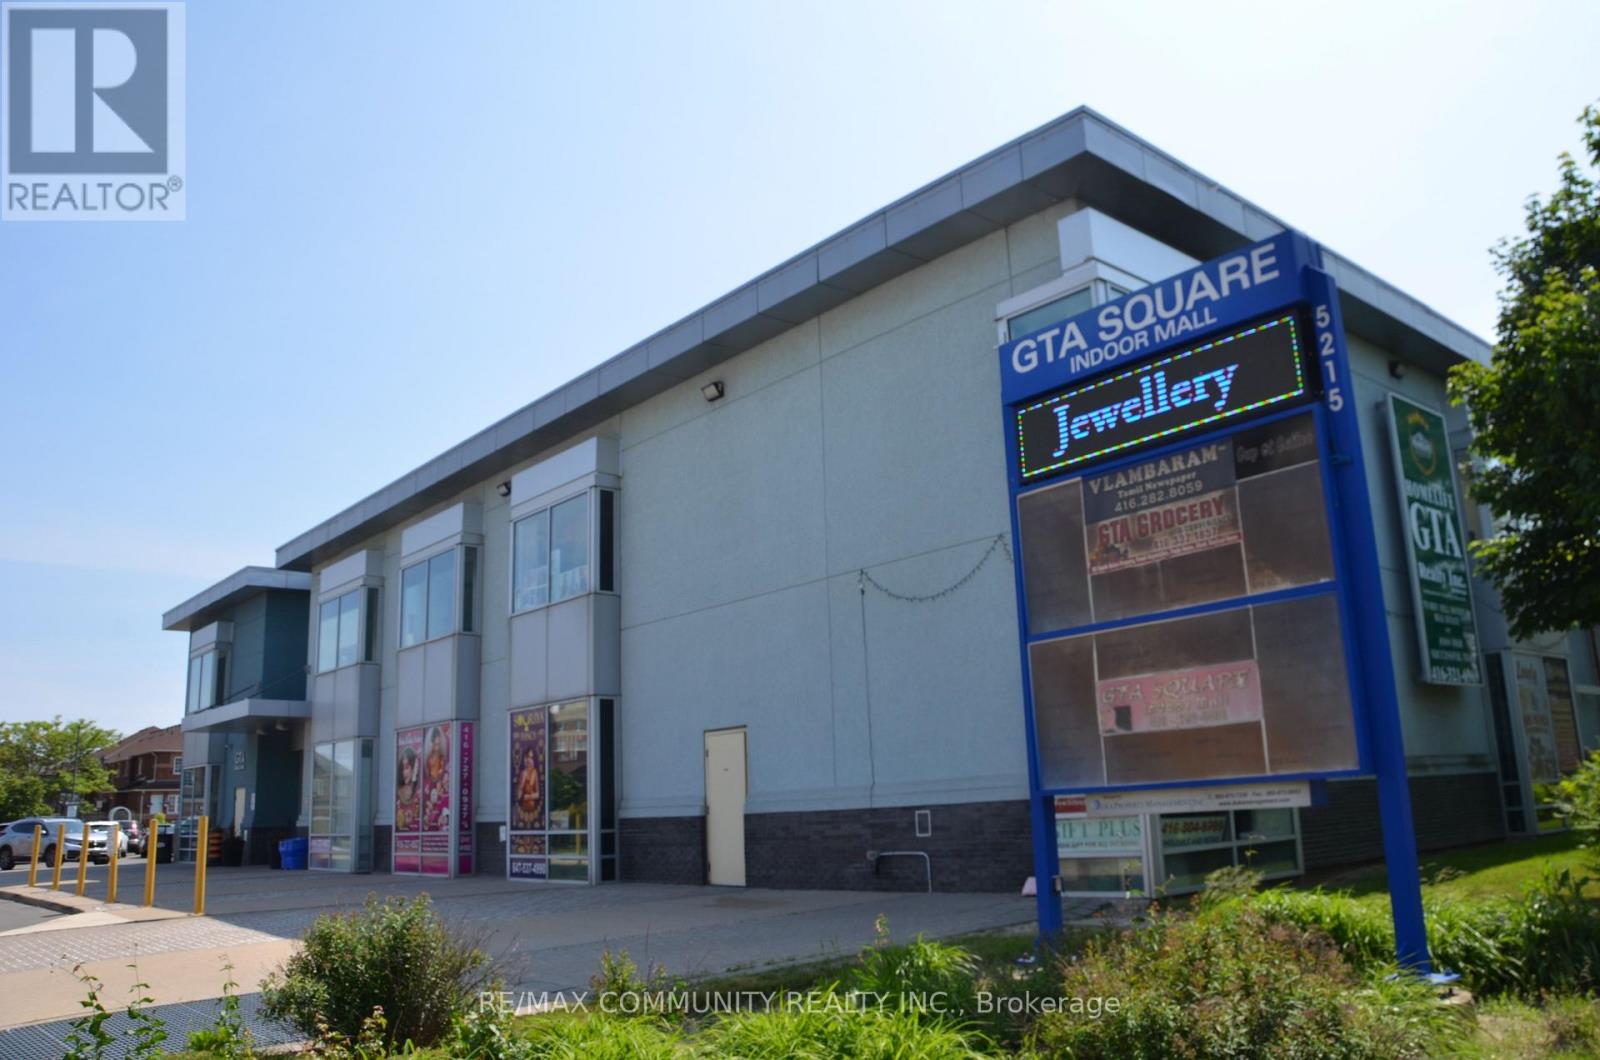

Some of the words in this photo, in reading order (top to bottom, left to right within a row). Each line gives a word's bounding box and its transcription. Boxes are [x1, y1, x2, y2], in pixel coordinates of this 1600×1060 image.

[1011, 320, 1089, 375] GTA
[1097, 243, 1280, 342] SQUARE
[1069, 331, 1150, 375] INDOOR
[1154, 306, 1218, 344] MALL
[1052, 363, 1240, 458] Jewellery
[1144, 471, 1197, 493] Newspaper
[1135, 494, 1225, 537] GROCERY
[1410, 502, 1463, 558] GTA
[1099, 817, 1141, 838] PLUS
